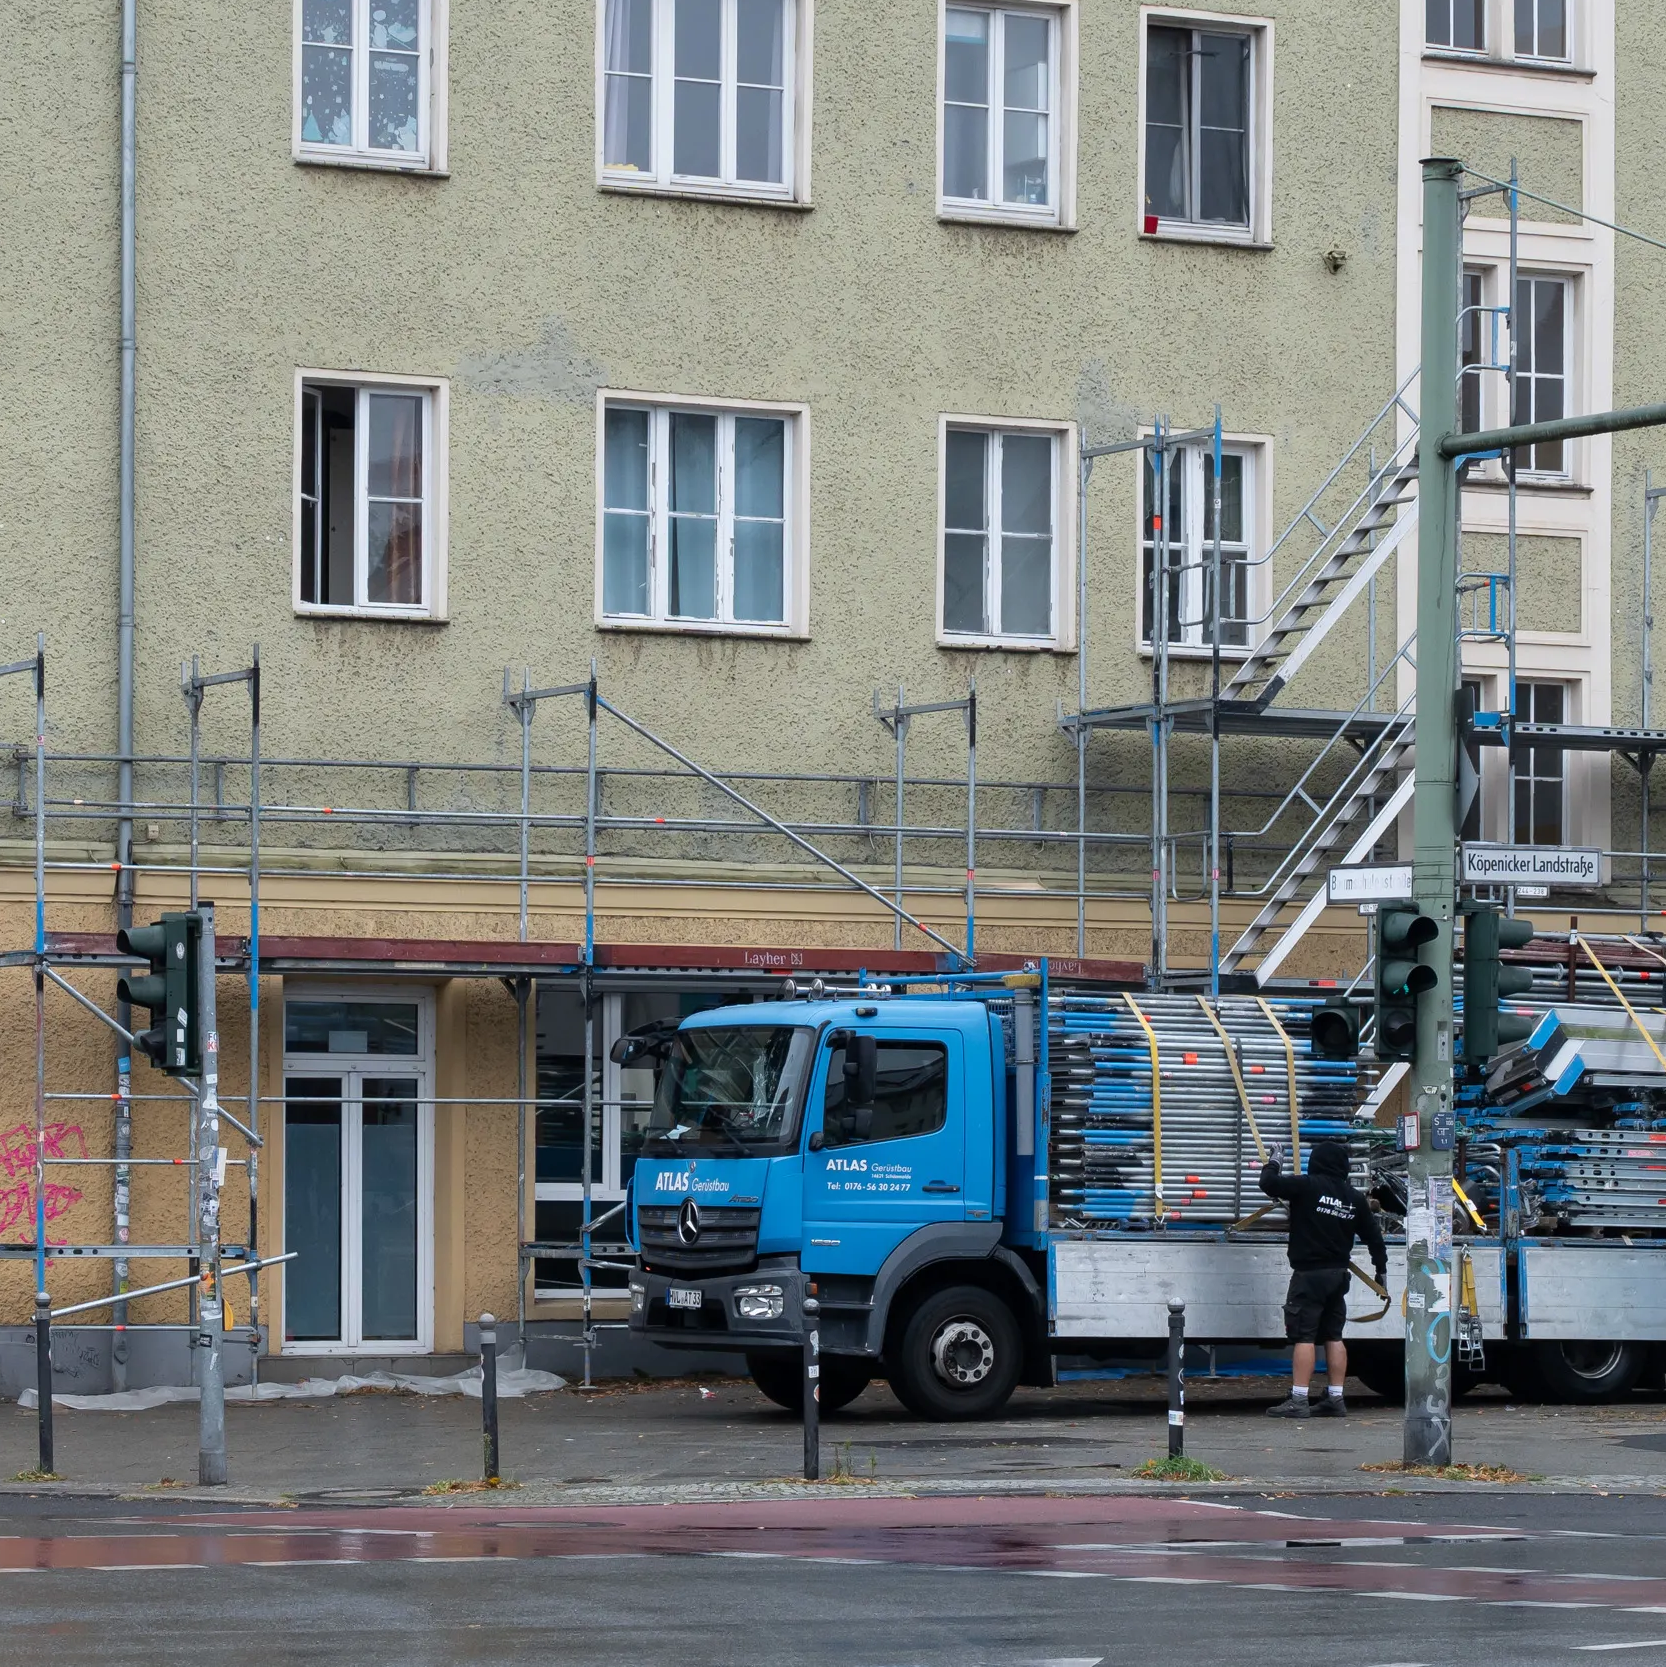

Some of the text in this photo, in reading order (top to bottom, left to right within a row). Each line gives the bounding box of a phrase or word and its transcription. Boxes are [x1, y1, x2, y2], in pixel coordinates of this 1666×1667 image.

[1468, 853, 1594, 878] Köpenicker Landstraße
[744, 951, 787, 967] Layher
[826, 1159, 913, 1173] ATLAS Gerüstbau
[655, 1172, 730, 1192] ATLAS Gerüstbau
[827, 1181, 841, 1190] Tel:
